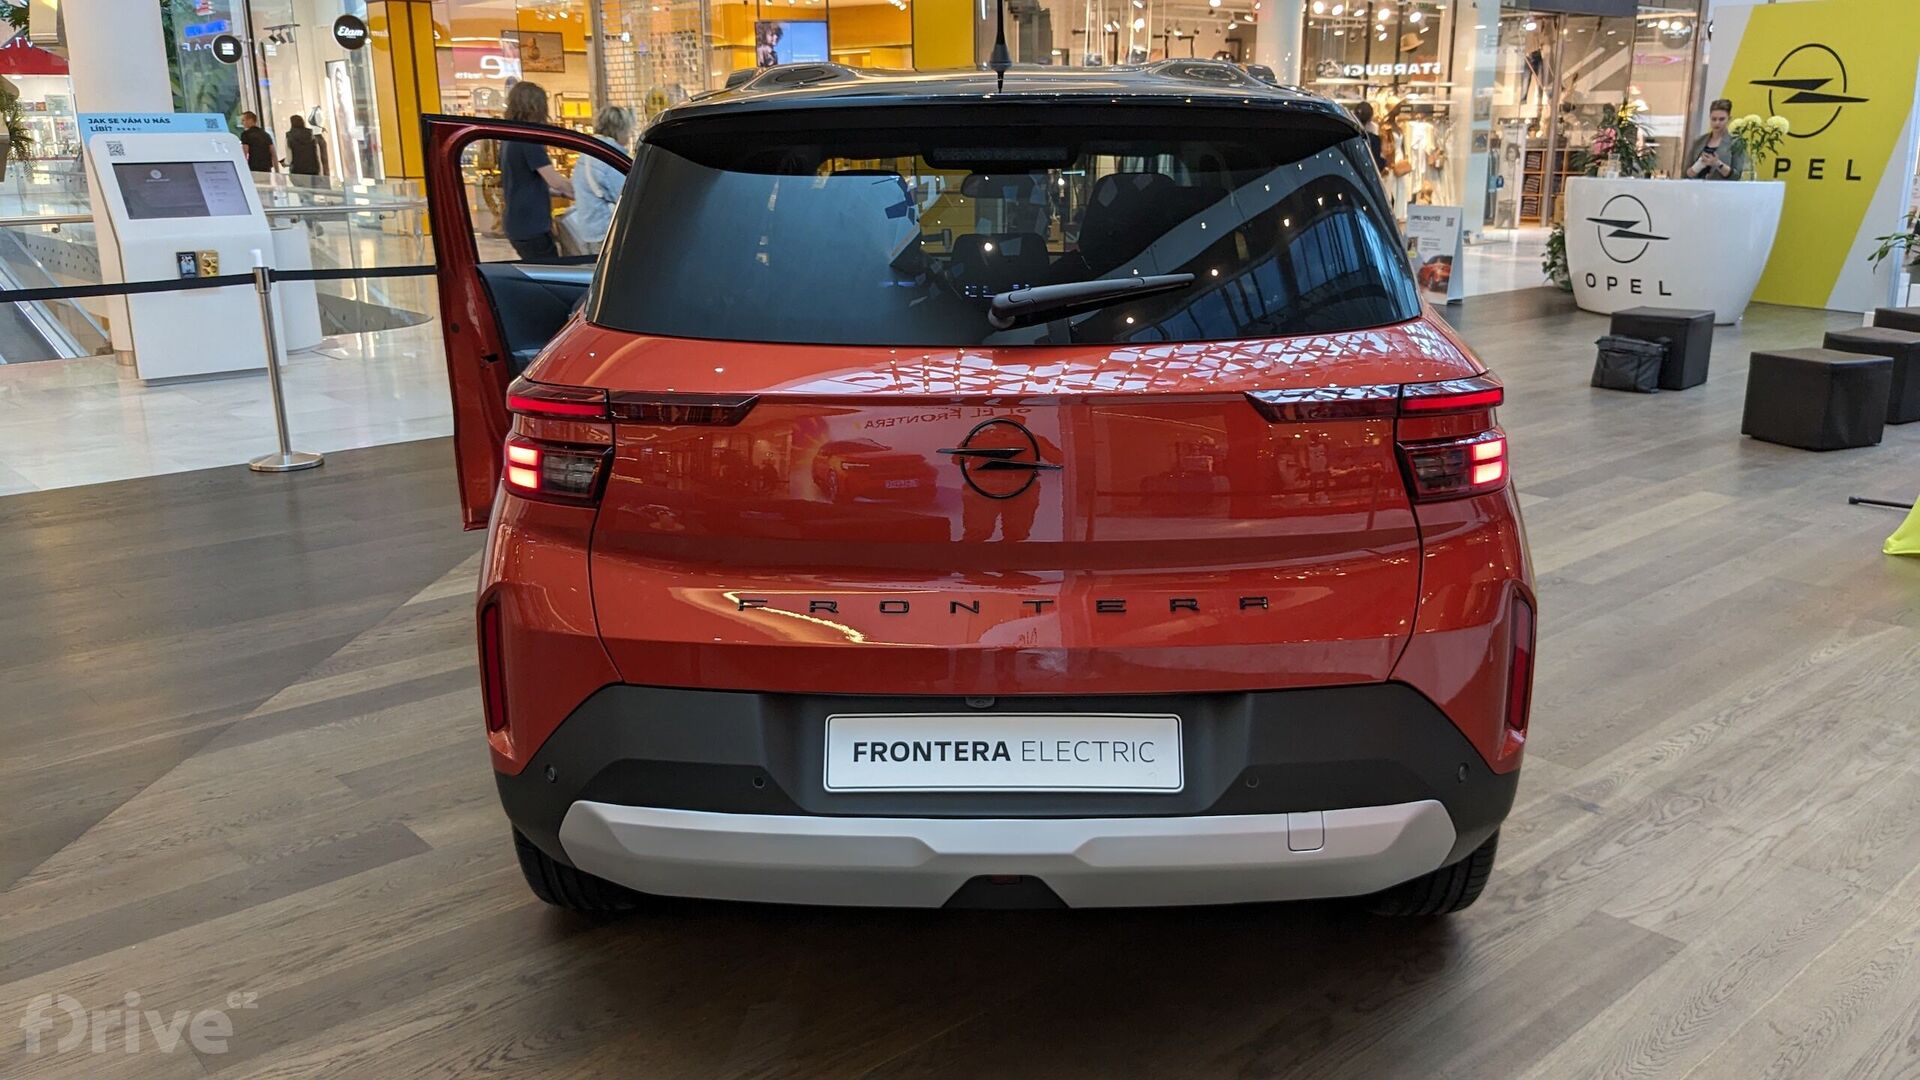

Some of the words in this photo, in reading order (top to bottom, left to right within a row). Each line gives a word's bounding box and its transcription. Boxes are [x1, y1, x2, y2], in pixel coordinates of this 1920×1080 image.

[337, 26, 364, 36] Etam
[121, 116, 142, 124] VÁM
[152, 116, 171, 124] NÁS
[1773, 158, 1862, 181] PEL
[1585, 272, 1672, 296] OPEL
[738, 596, 1268, 614] FRONTERA
[853, 740, 1011, 763] FRONTERA
[1021, 740, 1156, 763] ELECTRIC
